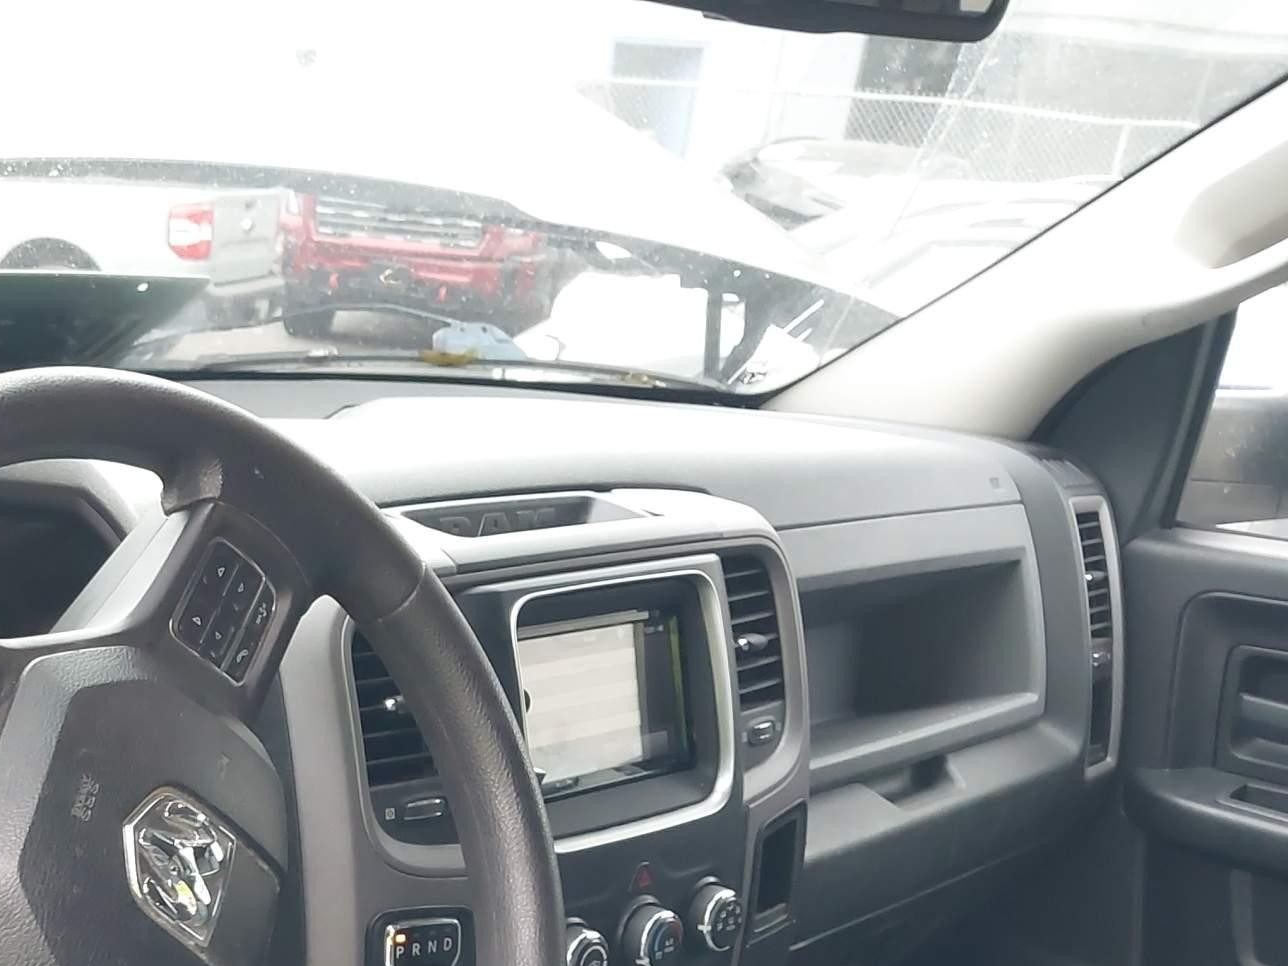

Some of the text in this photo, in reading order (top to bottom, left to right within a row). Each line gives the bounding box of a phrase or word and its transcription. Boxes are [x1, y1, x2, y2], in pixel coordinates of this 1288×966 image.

[396, 937, 453, 959] P R N D
